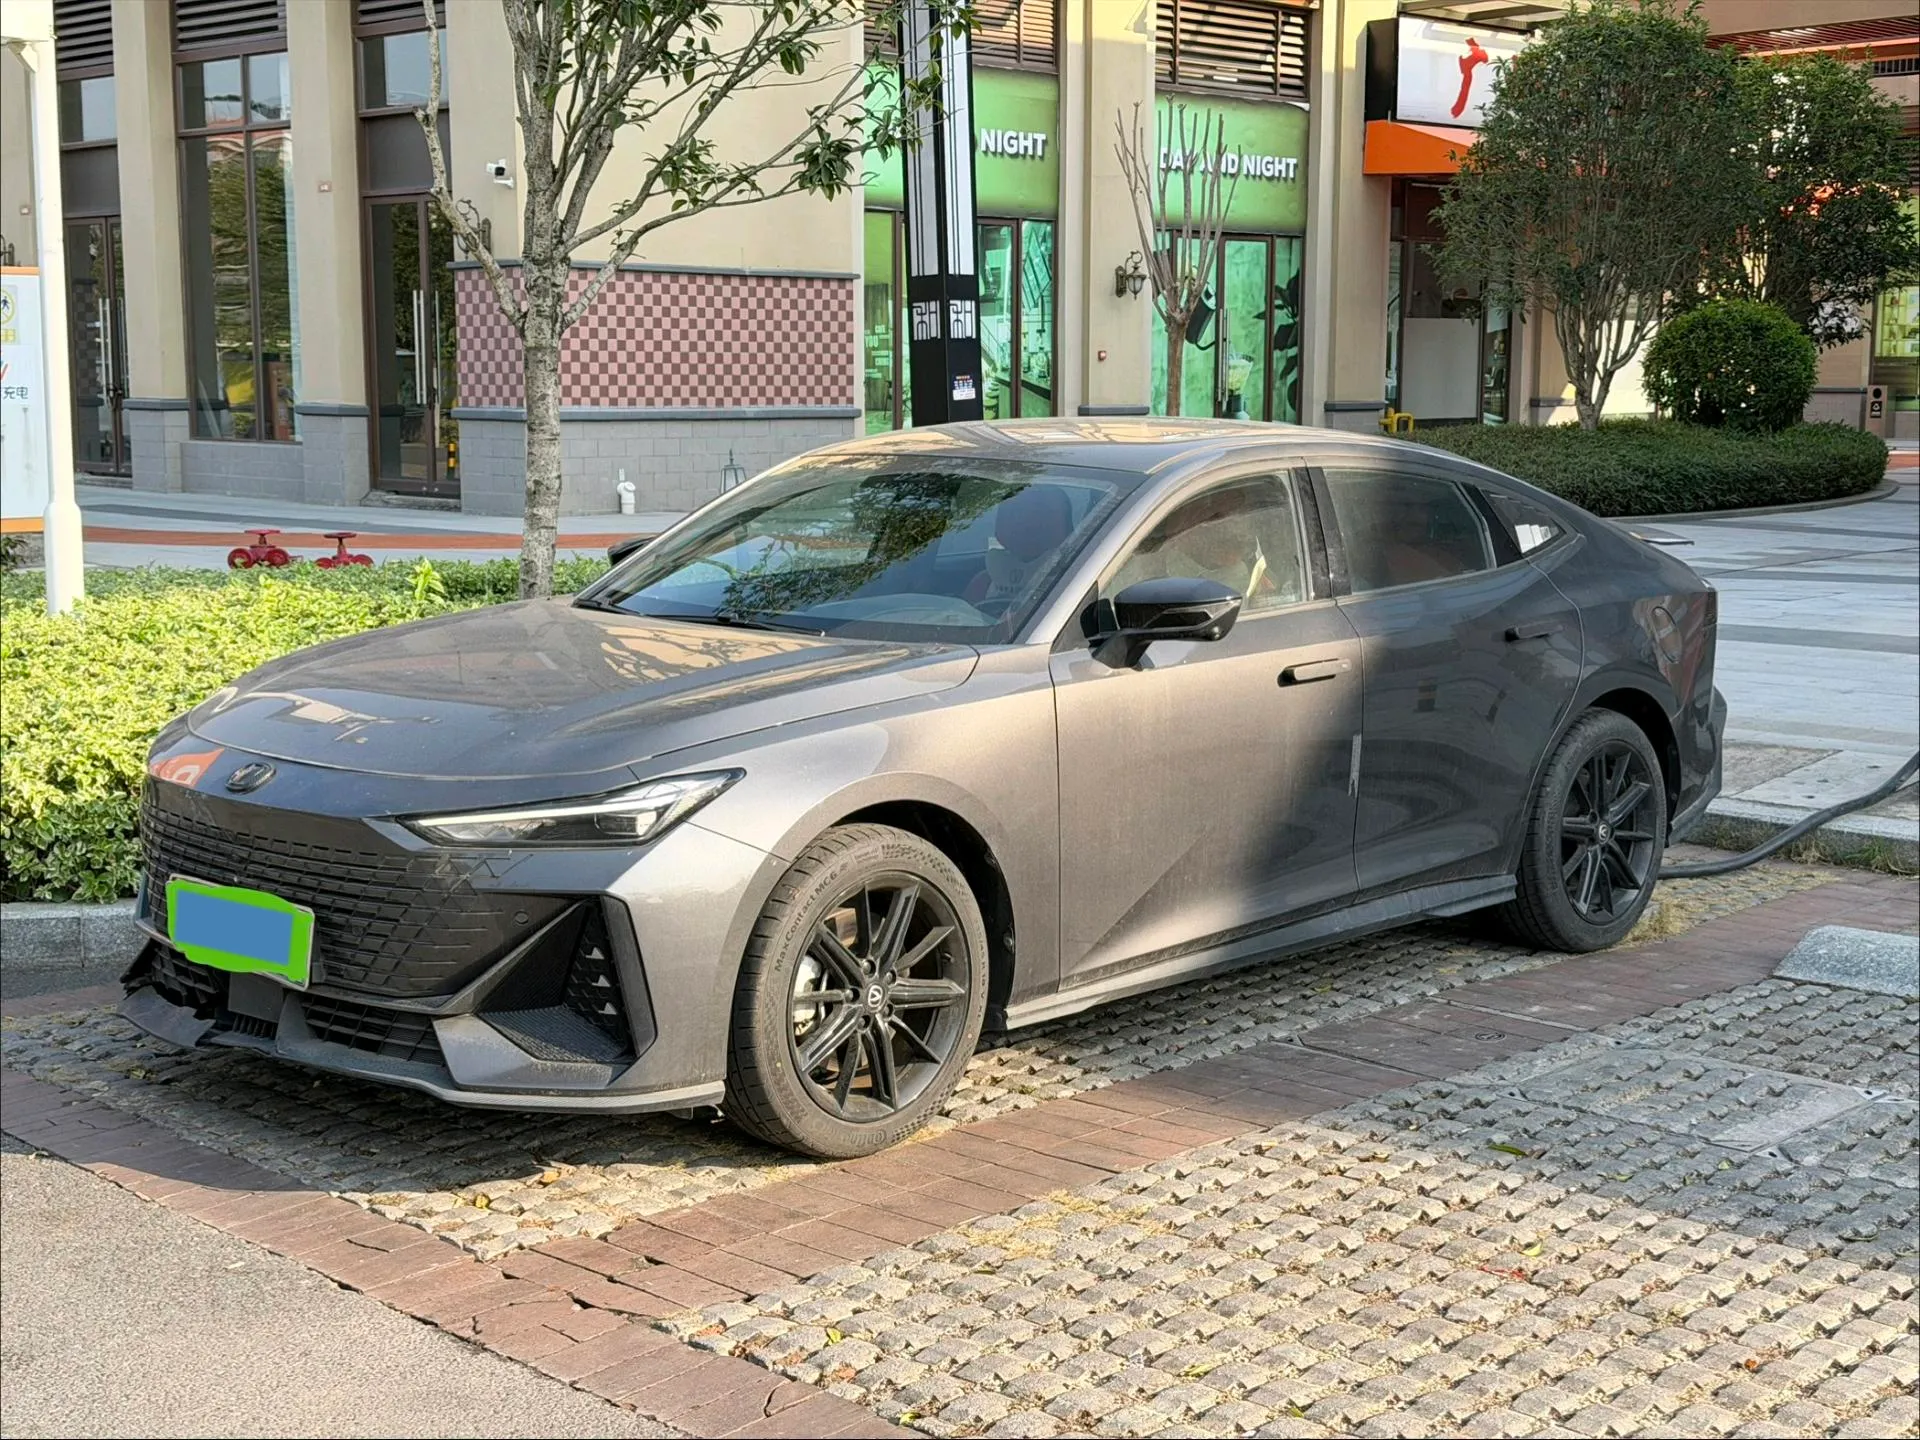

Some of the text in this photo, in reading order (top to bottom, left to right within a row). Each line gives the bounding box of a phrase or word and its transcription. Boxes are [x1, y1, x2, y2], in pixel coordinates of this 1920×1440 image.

[980, 128, 1047, 156] NIGHT
[1243, 155, 1297, 178] NIGHT
[3, 386, 28, 400] 充电
[774, 871, 838, 972] MaxContact MC6
